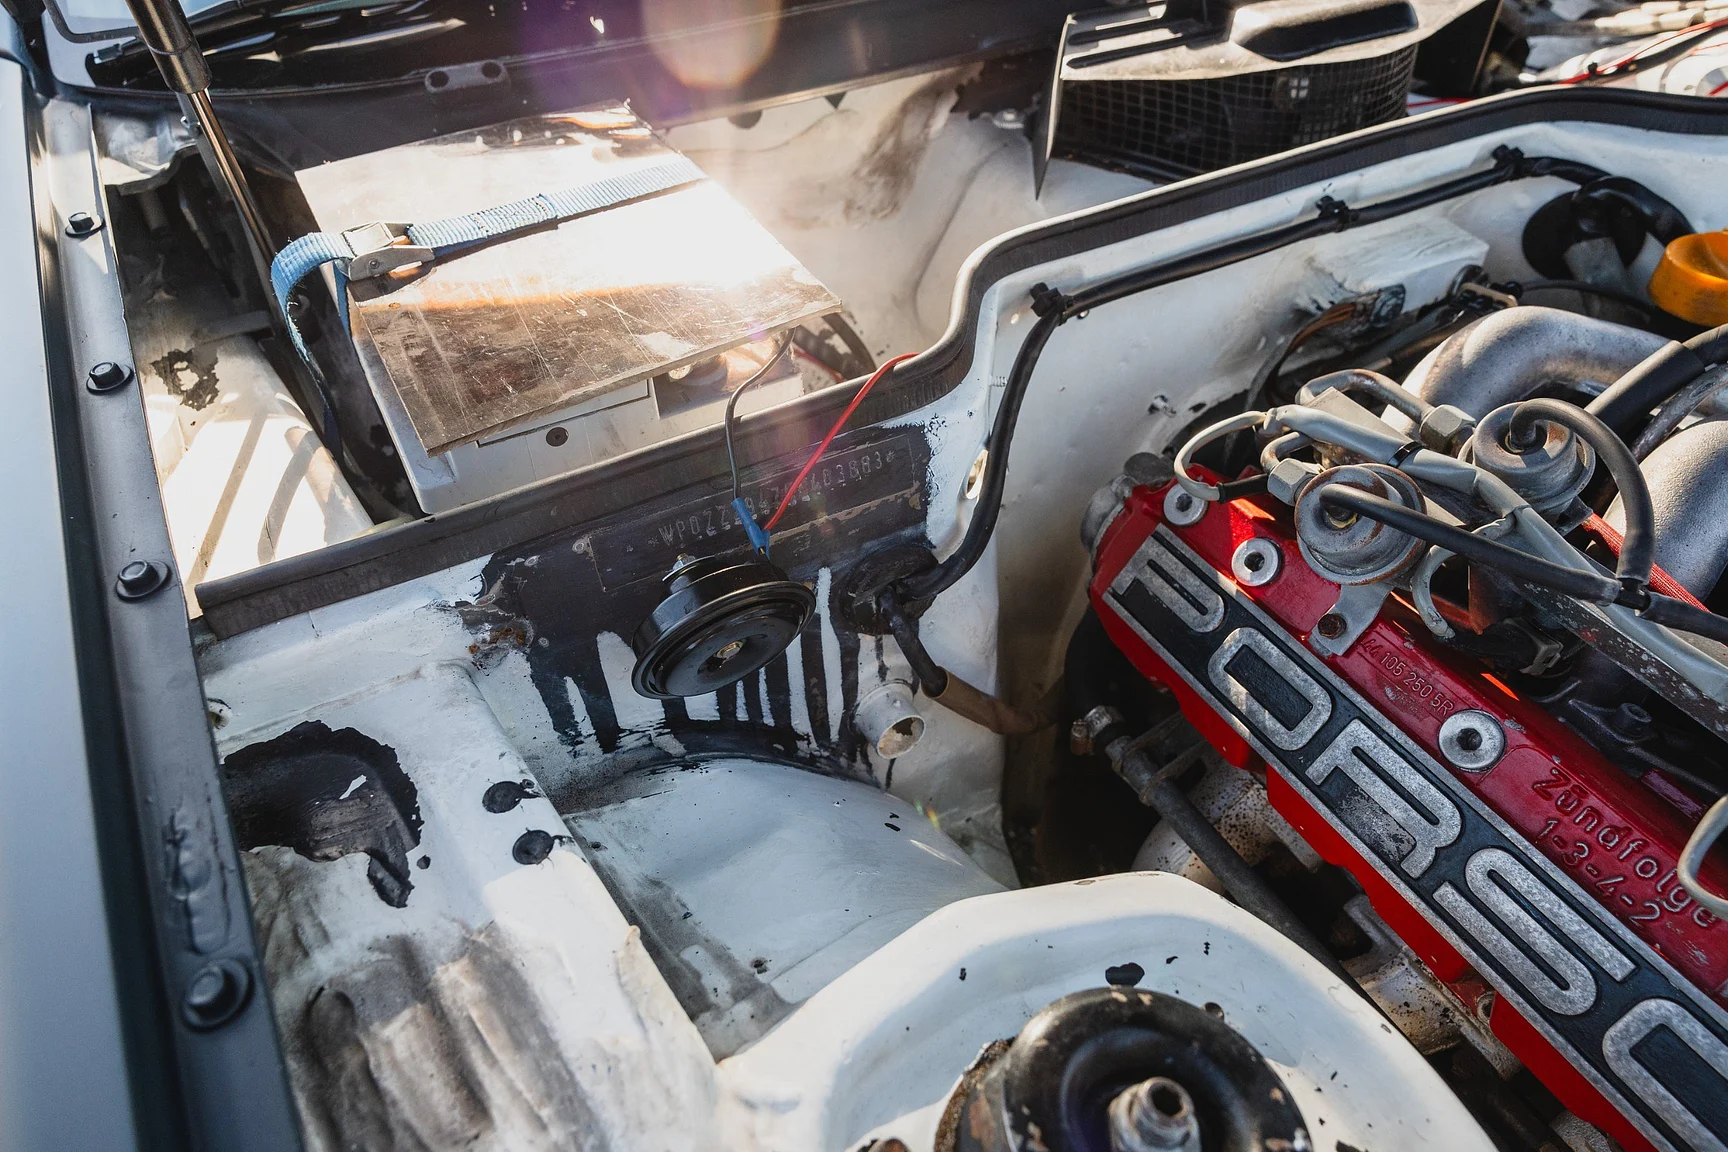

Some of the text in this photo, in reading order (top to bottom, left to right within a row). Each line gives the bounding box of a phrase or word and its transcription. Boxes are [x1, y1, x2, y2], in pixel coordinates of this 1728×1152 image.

[1380, 652, 1406, 676] 105
[1403, 672, 1433, 698] 250
[1430, 693, 1454, 716] 5R
[1535, 819, 1661, 928] 1-3-4-2
